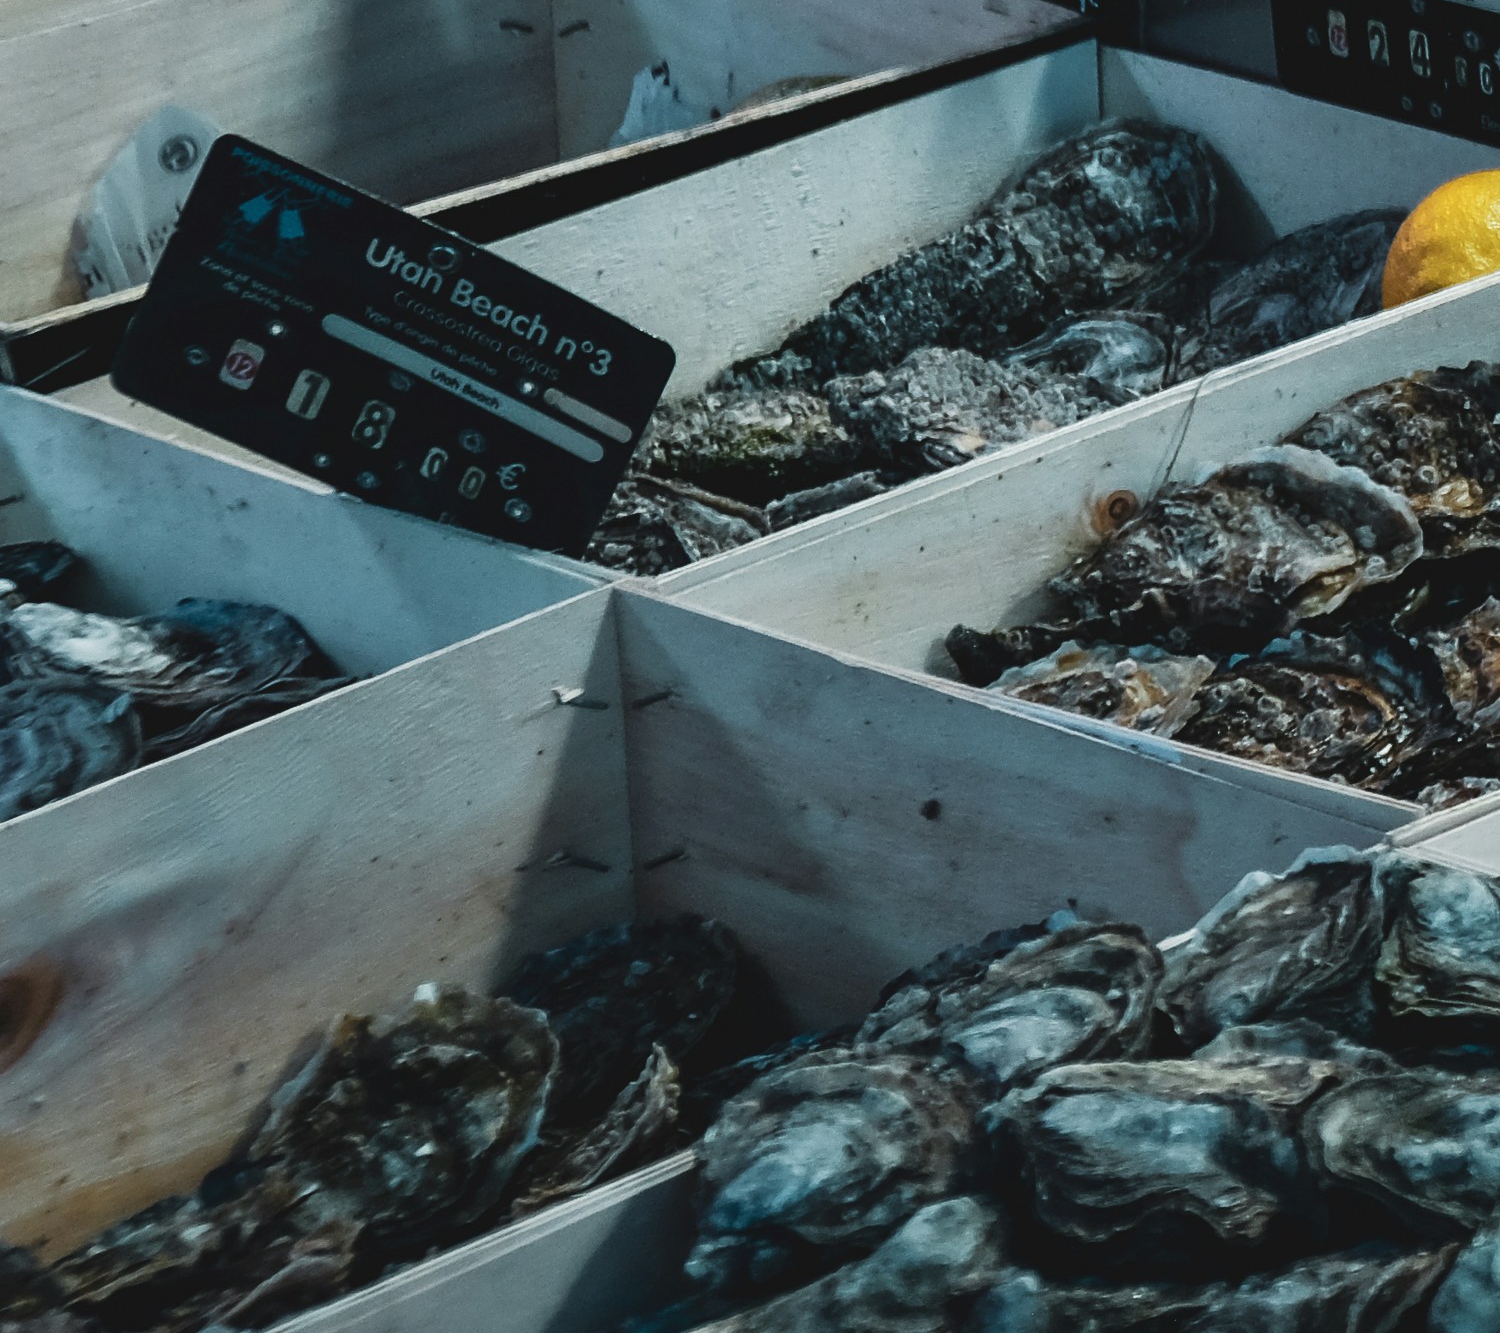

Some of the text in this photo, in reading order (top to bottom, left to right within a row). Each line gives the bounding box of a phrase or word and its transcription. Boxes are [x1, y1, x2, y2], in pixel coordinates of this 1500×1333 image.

[364, 236, 444, 296] Utah
[449, 276, 550, 347] Beach
[553, 334, 615, 378] n°3
[392, 289, 504, 355] Crassostrea
